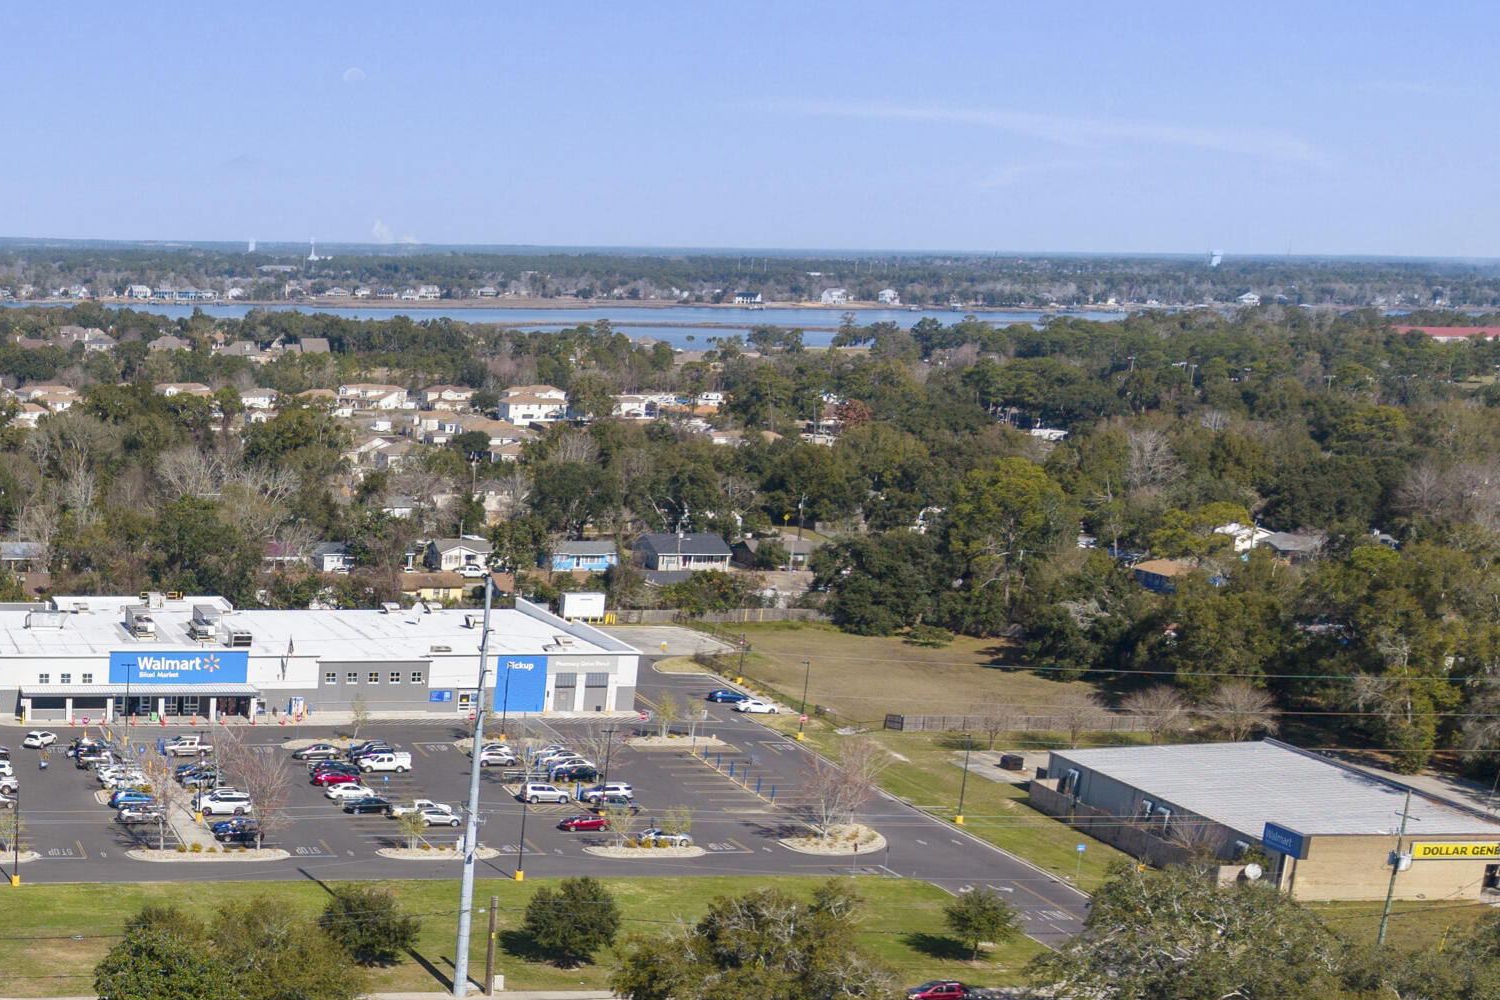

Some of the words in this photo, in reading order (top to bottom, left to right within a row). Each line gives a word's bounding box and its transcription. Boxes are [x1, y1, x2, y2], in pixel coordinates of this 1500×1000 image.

[137, 656, 201, 671] Walmart
[507, 661, 534, 671] Pickup
[1266, 828, 1292, 848] Walmart
[1423, 846, 1468, 856] DOLLAR
[1471, 846, 1500, 856] GENE
